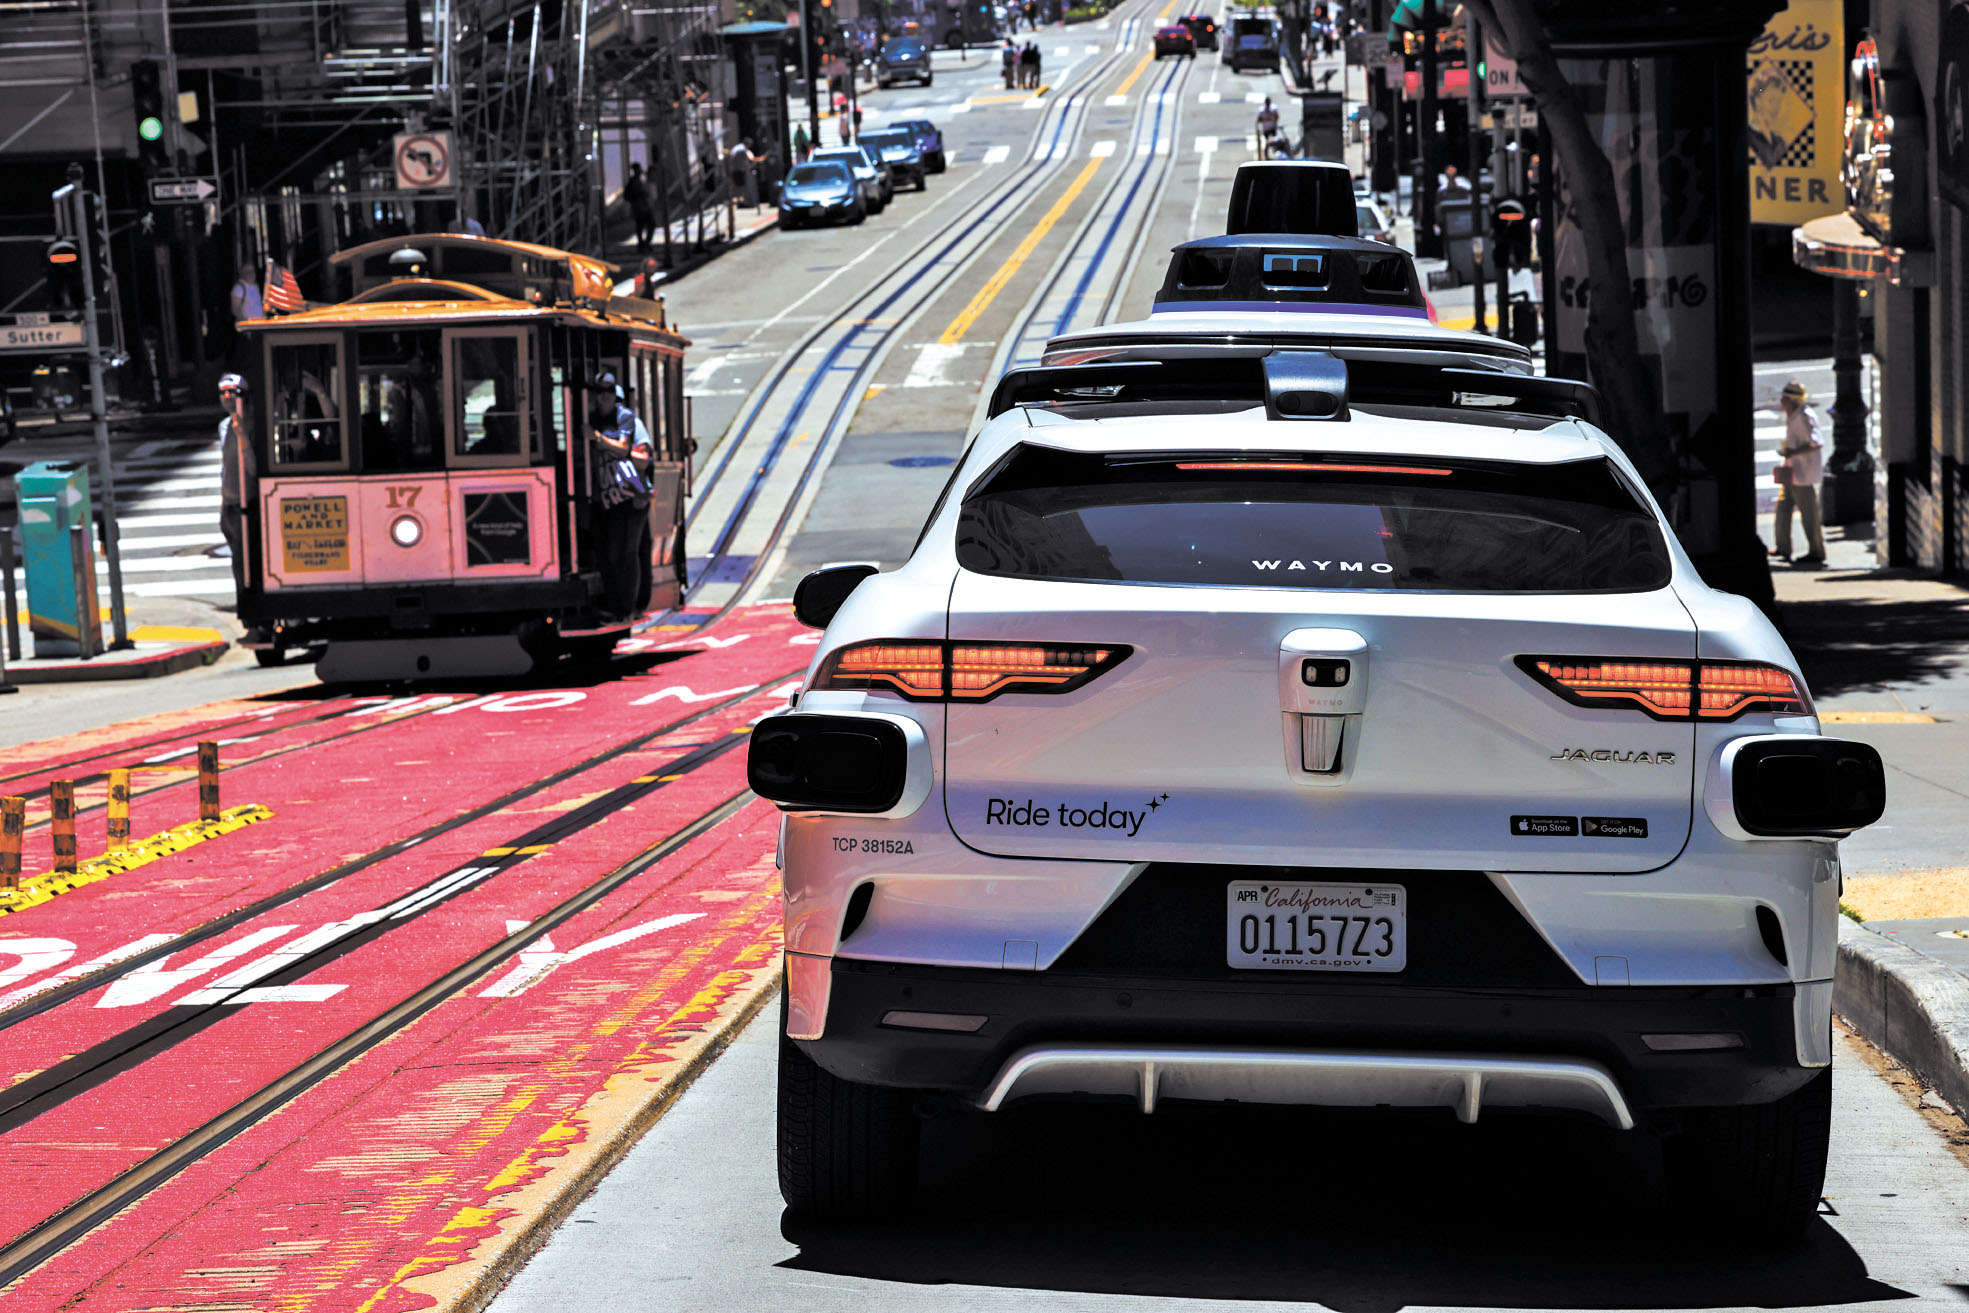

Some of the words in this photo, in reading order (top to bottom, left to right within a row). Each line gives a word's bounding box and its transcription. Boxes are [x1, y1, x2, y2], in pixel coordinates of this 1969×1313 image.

[1489, 70, 1509, 85] ON
[7, 330, 63, 344] Sutter
[385, 486, 422, 508] 17
[284, 503, 342, 514] POWELL
[301, 512, 328, 520] AND
[284, 519, 343, 530] MARKET
[1252, 560, 1393, 573] WAYMO
[1550, 748, 1676, 764] JAGUAR
[986, 798, 1050, 826] Ride
[1058, 801, 1146, 837] today
[1531, 824, 1548, 832] App
[1549, 824, 1571, 832] Store
[1601, 825, 1628, 834] Google
[1628, 825, 1644, 836] Play
[832, 837, 857, 852] TCP
[861, 839, 914, 854] 38152A
[1237, 890, 1258, 901] APR
[1265, 887, 1373, 913] California
[1240, 914, 1393, 957] 01157Z3
[1271, 957, 1362, 966] dmv.ca.gov
